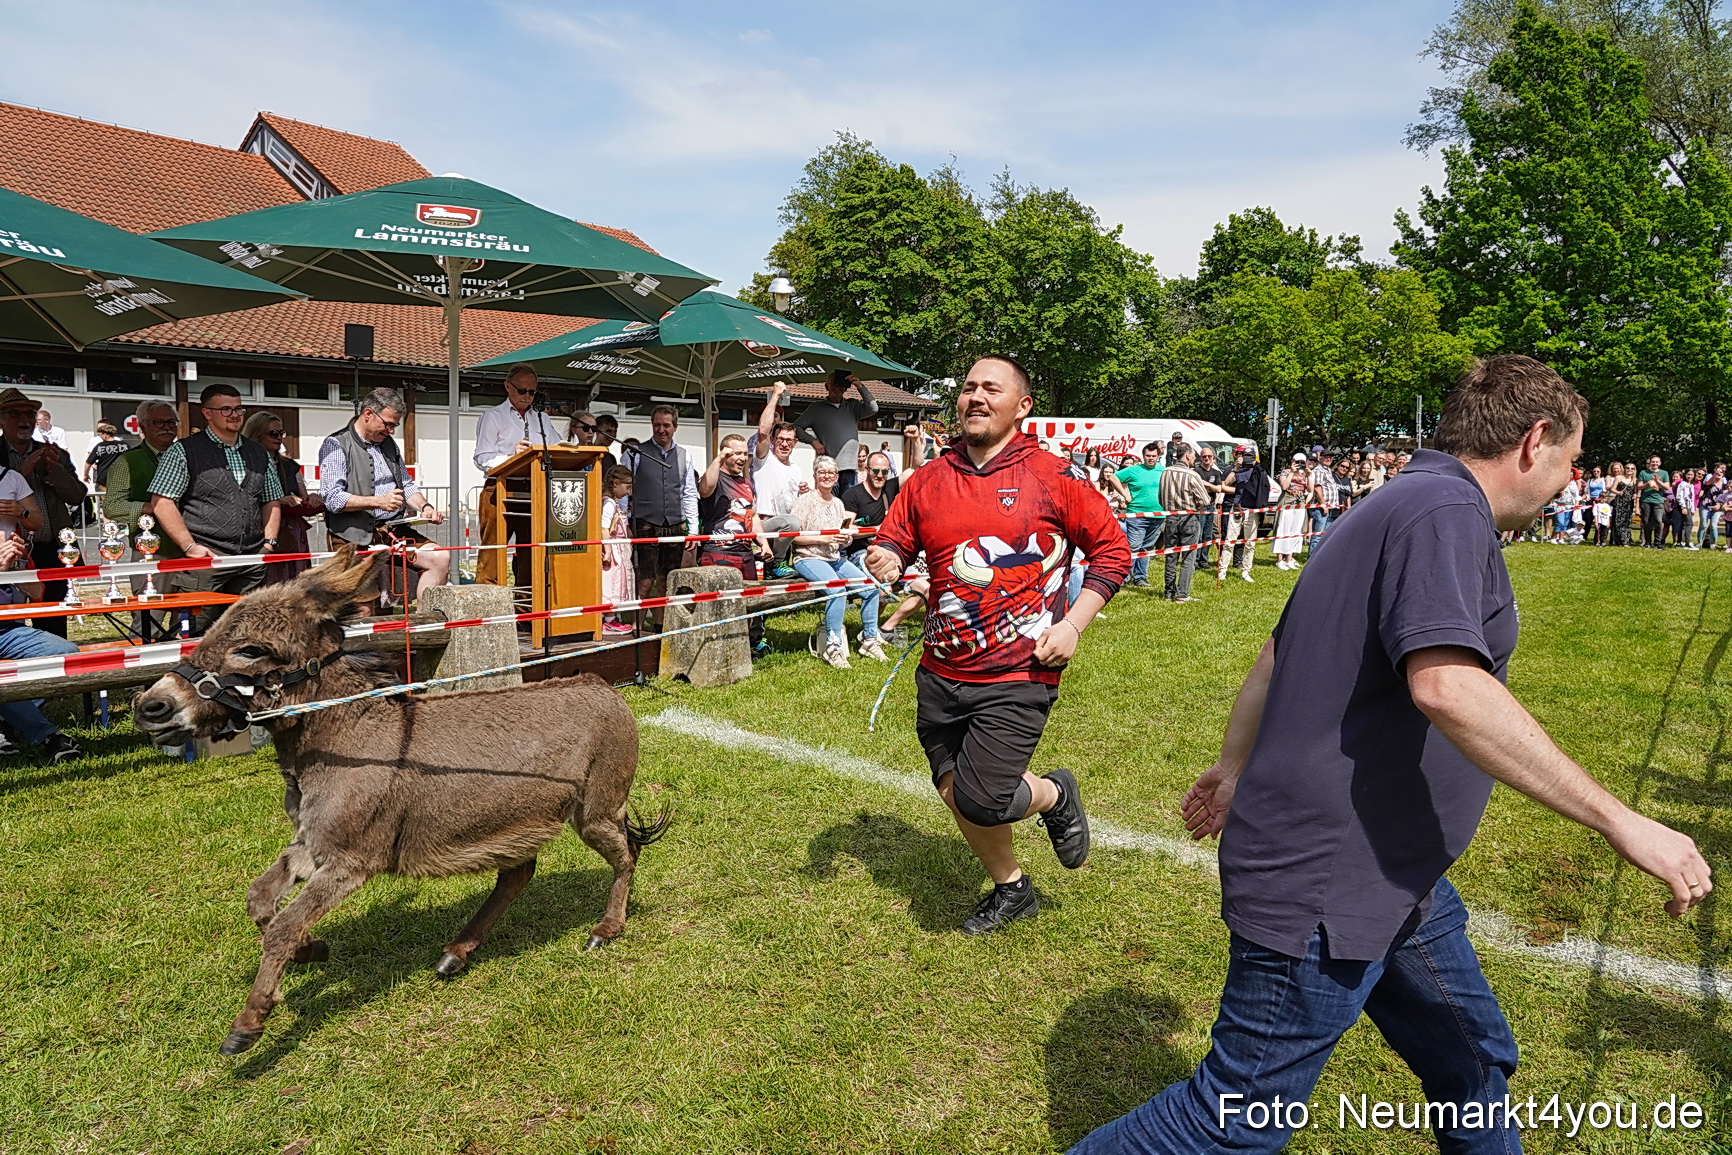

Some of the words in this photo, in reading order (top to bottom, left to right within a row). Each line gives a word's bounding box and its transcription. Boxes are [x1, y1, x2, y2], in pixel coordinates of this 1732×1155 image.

[354, 228, 530, 253] Lammsbräu
[380, 224, 508, 242] Neumarkter
[559, 530, 577, 540] Stadt
